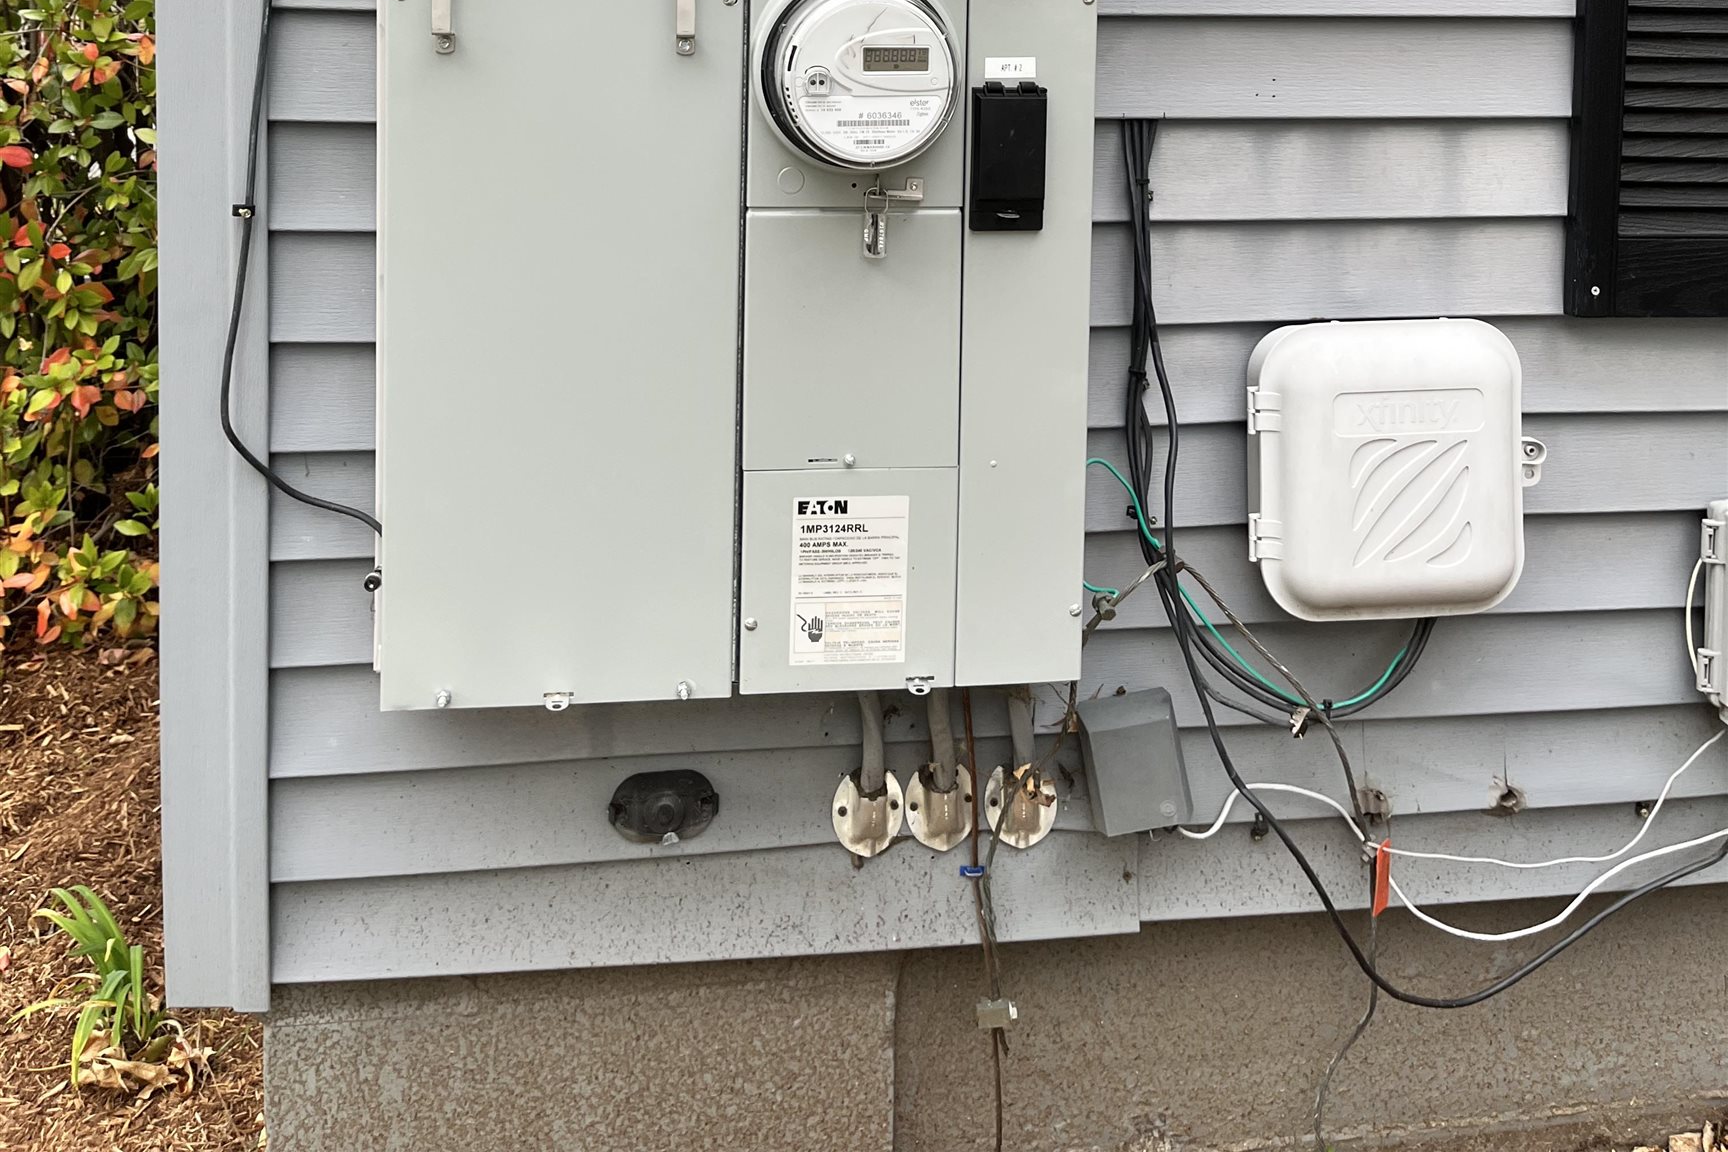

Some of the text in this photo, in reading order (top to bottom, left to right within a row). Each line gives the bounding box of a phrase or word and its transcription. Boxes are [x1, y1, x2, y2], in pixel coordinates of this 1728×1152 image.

[909, 98, 929, 107] elster
[866, 111, 903, 120] 6036346
[1355, 398, 1460, 432] xfinity
[797, 500, 848, 515] EATON
[800, 524, 869, 534] 1MP3124RRL
